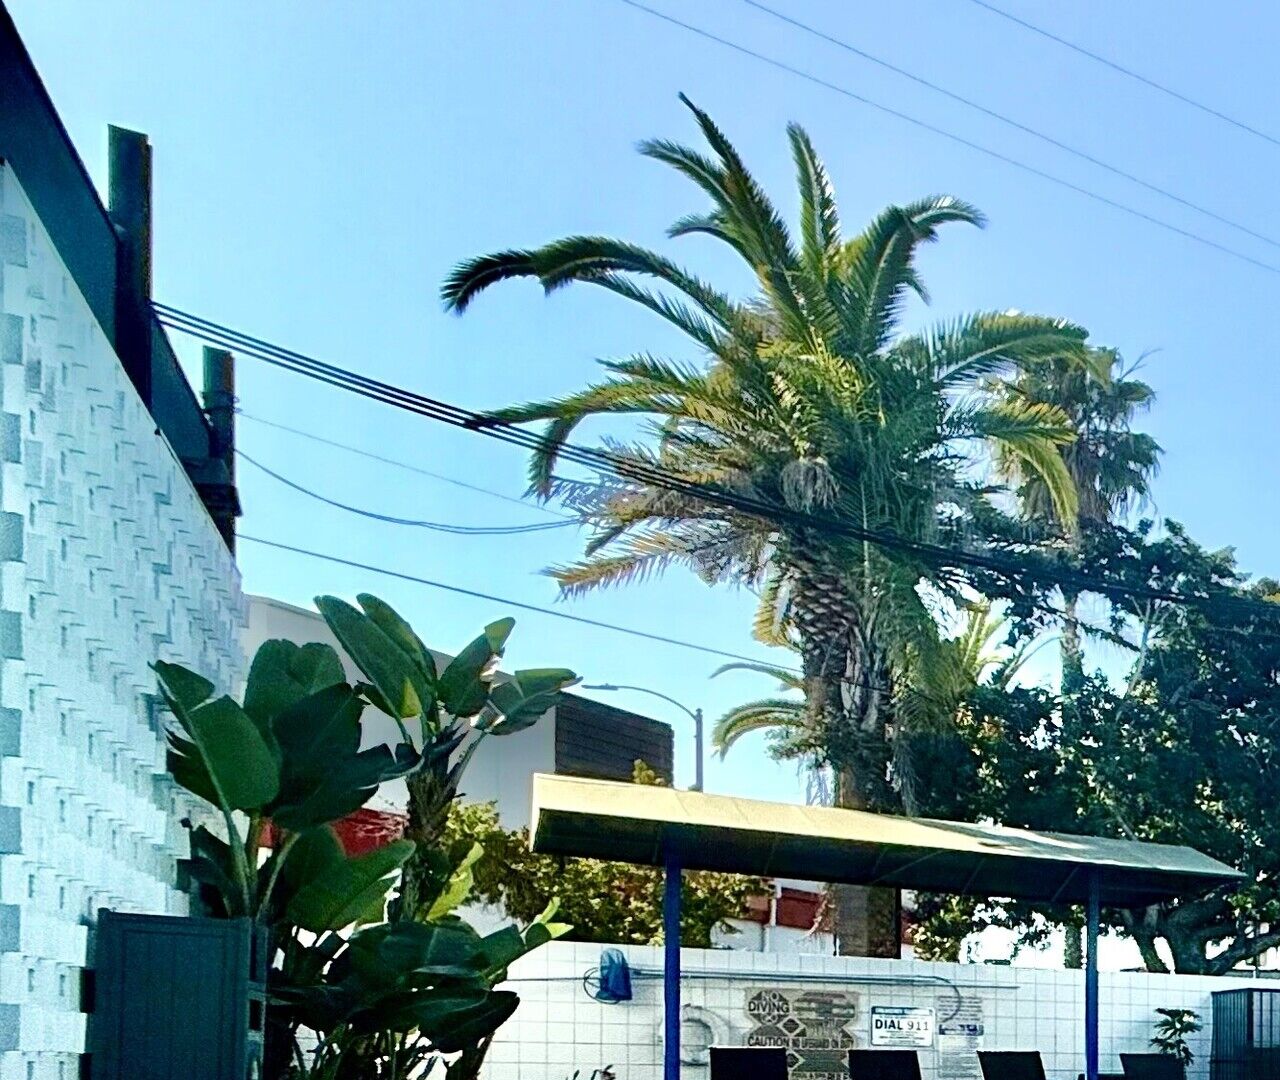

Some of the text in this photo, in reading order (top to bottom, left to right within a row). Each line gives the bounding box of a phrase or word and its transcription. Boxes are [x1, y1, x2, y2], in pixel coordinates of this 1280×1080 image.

[761, 991, 780, 1002] NO
[748, 1001, 790, 1013] DIVING
[875, 1019, 903, 1030] DIAL
[907, 1020, 929, 1031] 911
[747, 1036, 789, 1048] CAUTION
